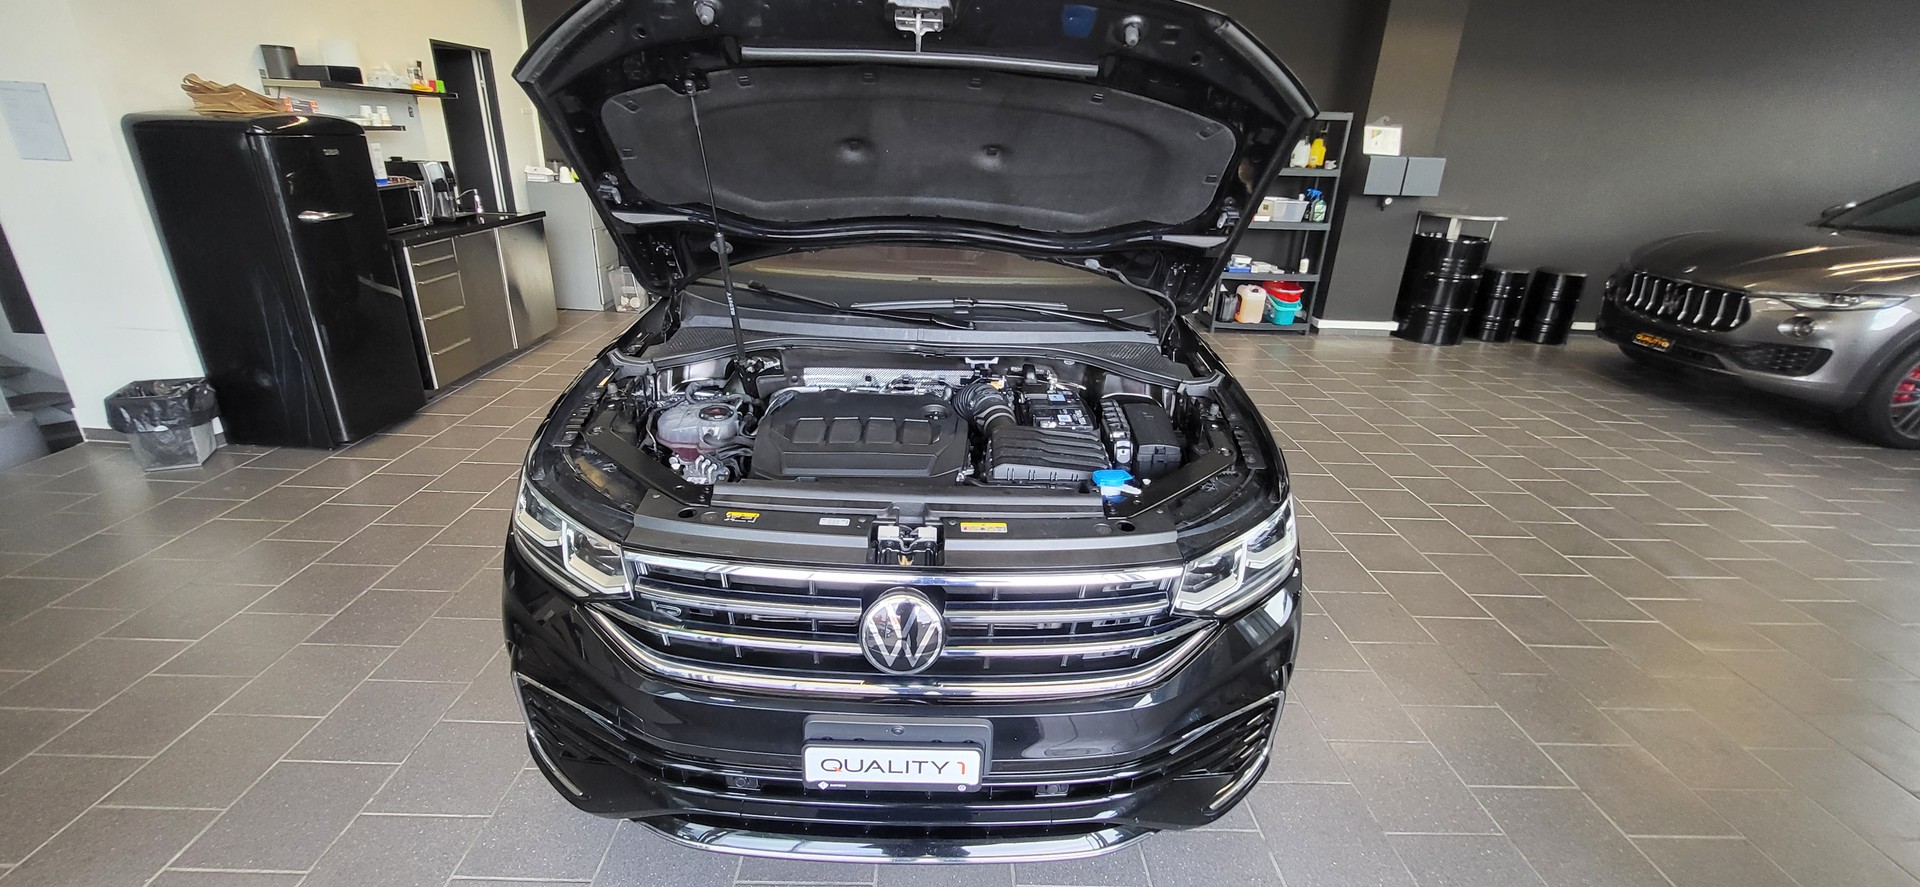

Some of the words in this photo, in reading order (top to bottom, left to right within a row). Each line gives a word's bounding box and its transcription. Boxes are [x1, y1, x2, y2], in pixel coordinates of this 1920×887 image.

[865, 598, 940, 669] VW
[820, 758, 949, 775] QUALITY
[957, 761, 966, 775] 1
